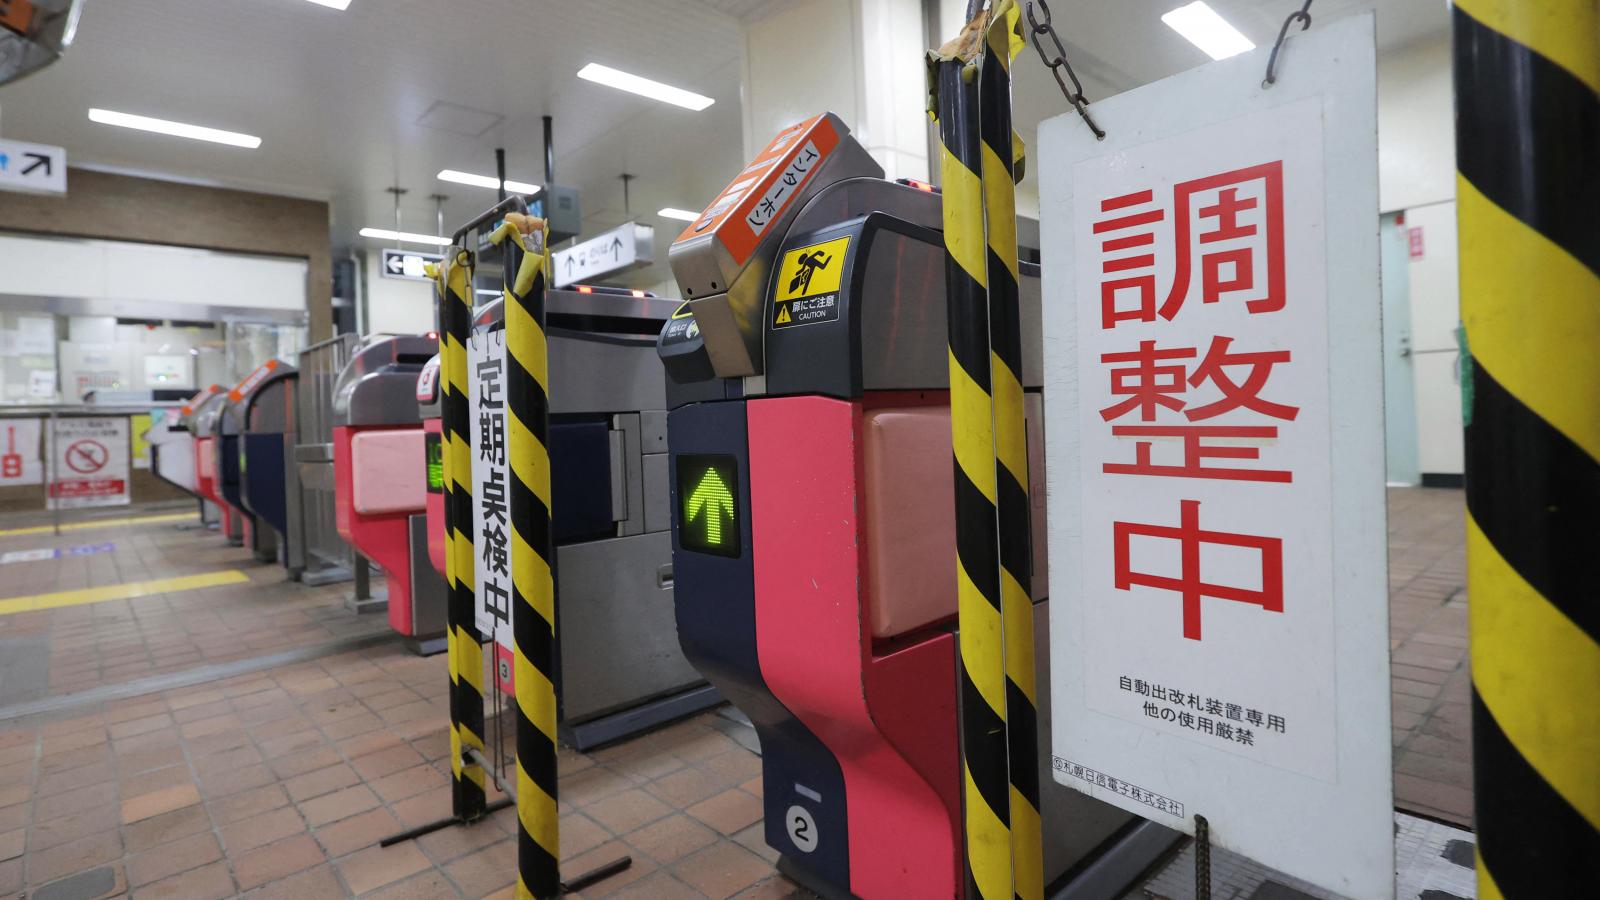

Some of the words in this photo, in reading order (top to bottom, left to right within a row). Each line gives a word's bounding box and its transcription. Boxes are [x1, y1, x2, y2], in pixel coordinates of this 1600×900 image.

[749, 149, 817, 226] インターホン
[792, 295, 834, 312] 扉にご注意
[798, 310, 826, 320] CAUTION
[1093, 160, 1300, 641] 調整中
[501, 664, 508, 678] 3
[1119, 675, 1286, 734] 自動出改札装置専用
[1143, 700, 1255, 747] 他の使用厳禁
[794, 815, 809, 842] 2
